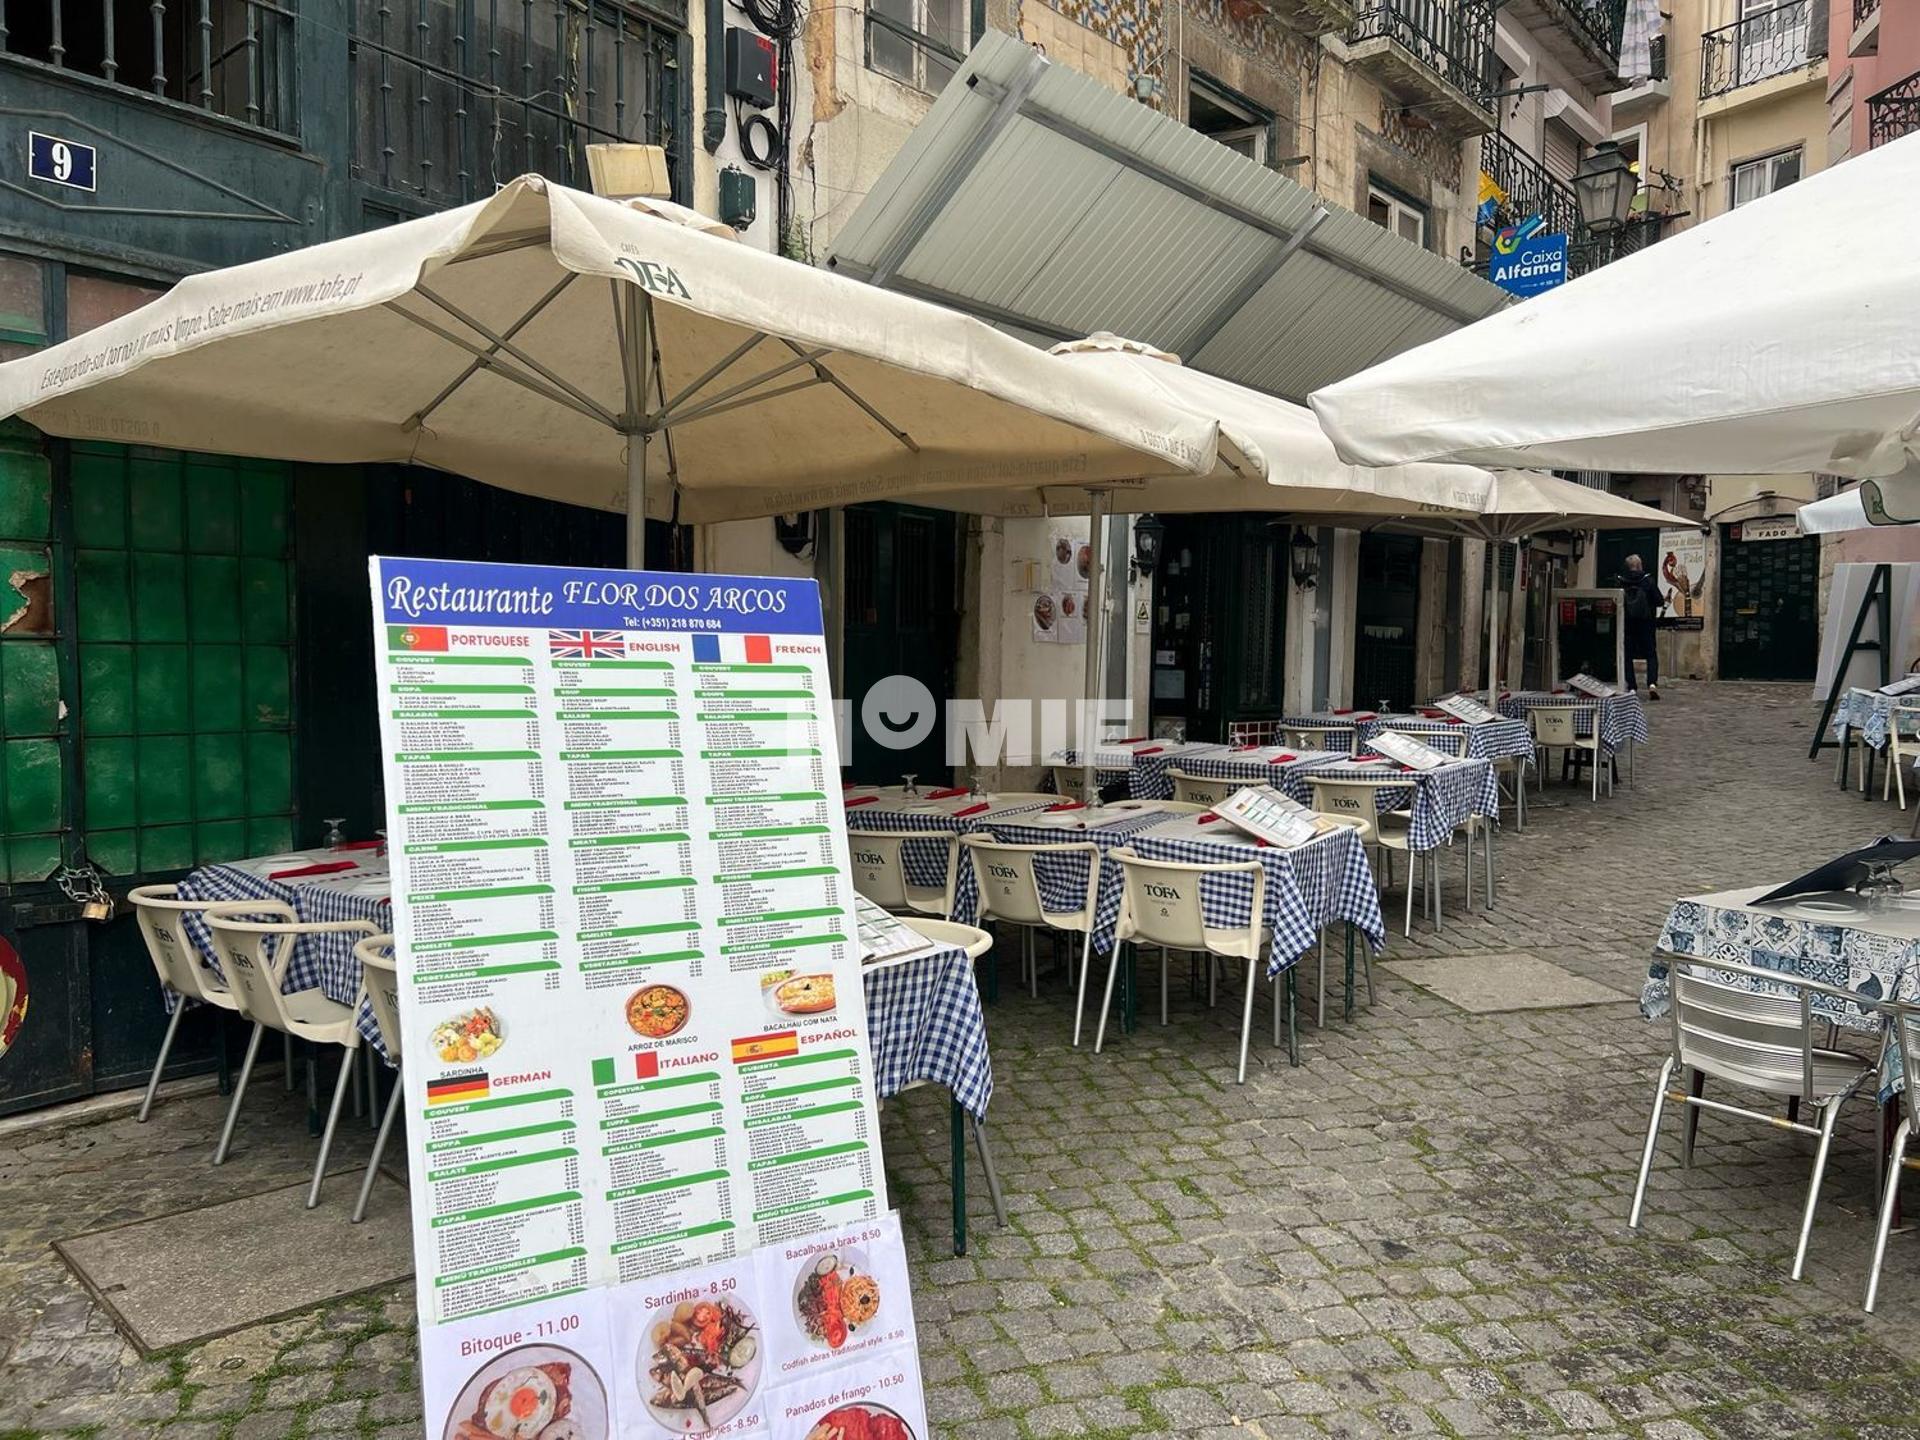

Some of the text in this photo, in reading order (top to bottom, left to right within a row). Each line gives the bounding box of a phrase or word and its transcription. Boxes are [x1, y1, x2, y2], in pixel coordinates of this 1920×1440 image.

[49, 142, 73, 182] 9
[1521, 250, 1562, 265] Caixa
[1494, 262, 1562, 282] Alfama
[260, 289, 283, 312] em
[1759, 530, 1787, 538] FADO
[388, 576, 787, 617] Restaurante FLOR DOS ARCOS
[623, 616, 722, 630] Tel: (+351) 218 870 684
[451, 635, 530, 647] PORTUGUESE
[629, 642, 680, 653] ENGLISH
[775, 645, 821, 655] FRENCH
[1332, 798, 1361, 809] TOFA
[854, 853, 886, 865] TOFA
[988, 865, 1019, 879] TOFA
[1144, 884, 1181, 899] TOFA
[763, 1015, 837, 1032] BACALHAU COM NATA
[799, 1026, 857, 1044] ESPAÑOL
[627, 1034, 698, 1052] ARROZ DE MARISCO
[659, 1051, 719, 1068] ITALIANO
[439, 1065, 483, 1078] SARDINHA
[492, 1070, 551, 1087] GERMAN
[603, 1084, 645, 1096] COPERTURA
[429, 1105, 470, 1116] COUVERT
[751, 1159, 776, 1168] TAPAS
[433, 1166, 466, 1178] SALATE
[612, 1188, 636, 1197] TAPAS
[436, 1214, 466, 1225] TAPAS
[786, 1241, 828, 1260] Bacalhau
[829, 1241, 836, 1250] a
[862, 1228, 881, 1242] 8.50
[644, 1286, 699, 1310] Sardinha
[710, 1277, 737, 1295] 8.50
[461, 1331, 522, 1357] Bitoque
[537, 1315, 580, 1337] 11.00
[781, 1355, 809, 1372] Codfish
[810, 1350, 830, 1363] abras
[831, 1338, 867, 1359] traditional
[867, 1336, 883, 1350] style
[786, 1398, 827, 1418] Panados
[828, 1393, 841, 1405] de
[841, 1384, 872, 1402] frango
[879, 1373, 905, 1390] 10.50
